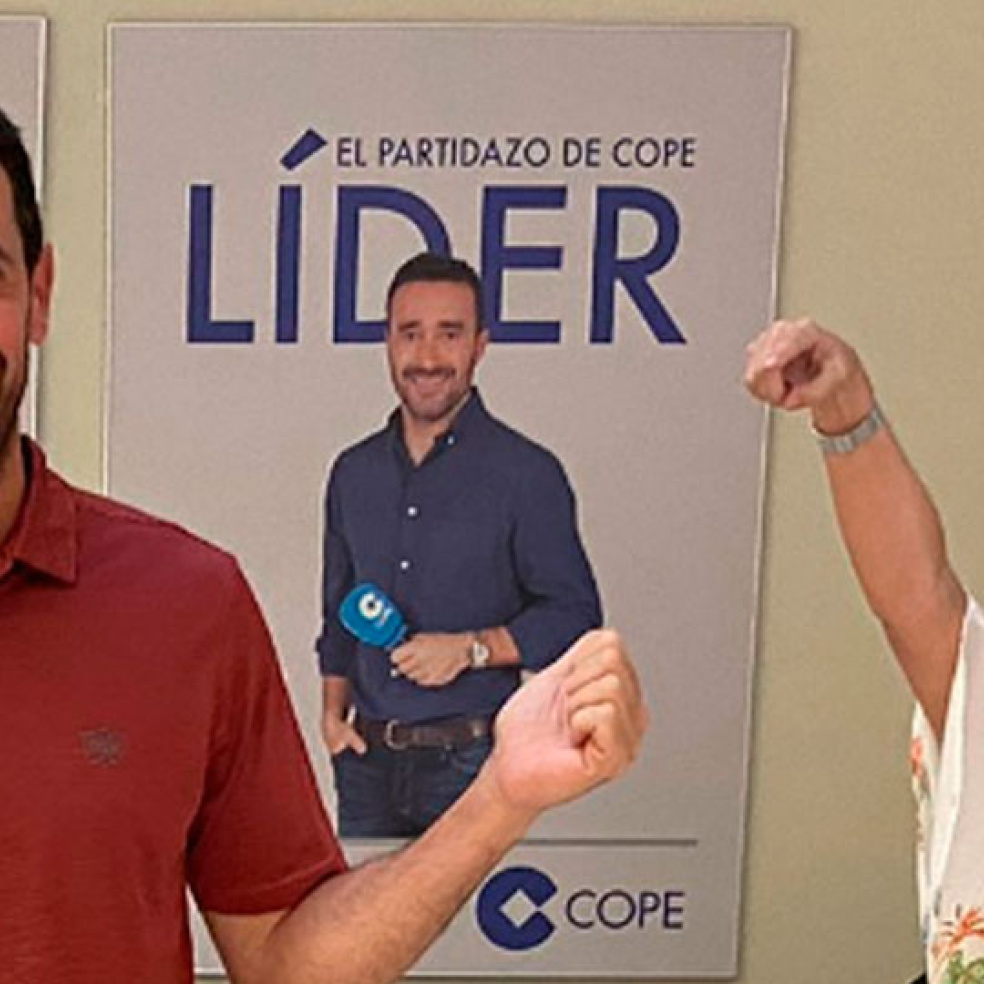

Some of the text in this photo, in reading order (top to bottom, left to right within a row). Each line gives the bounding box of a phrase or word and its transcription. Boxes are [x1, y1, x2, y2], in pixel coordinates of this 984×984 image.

[336, 137, 696, 168] EL PARTIDAZO DE COPE
[185, 128, 688, 344] LÍDER
[565, 890, 686, 929] COPE
